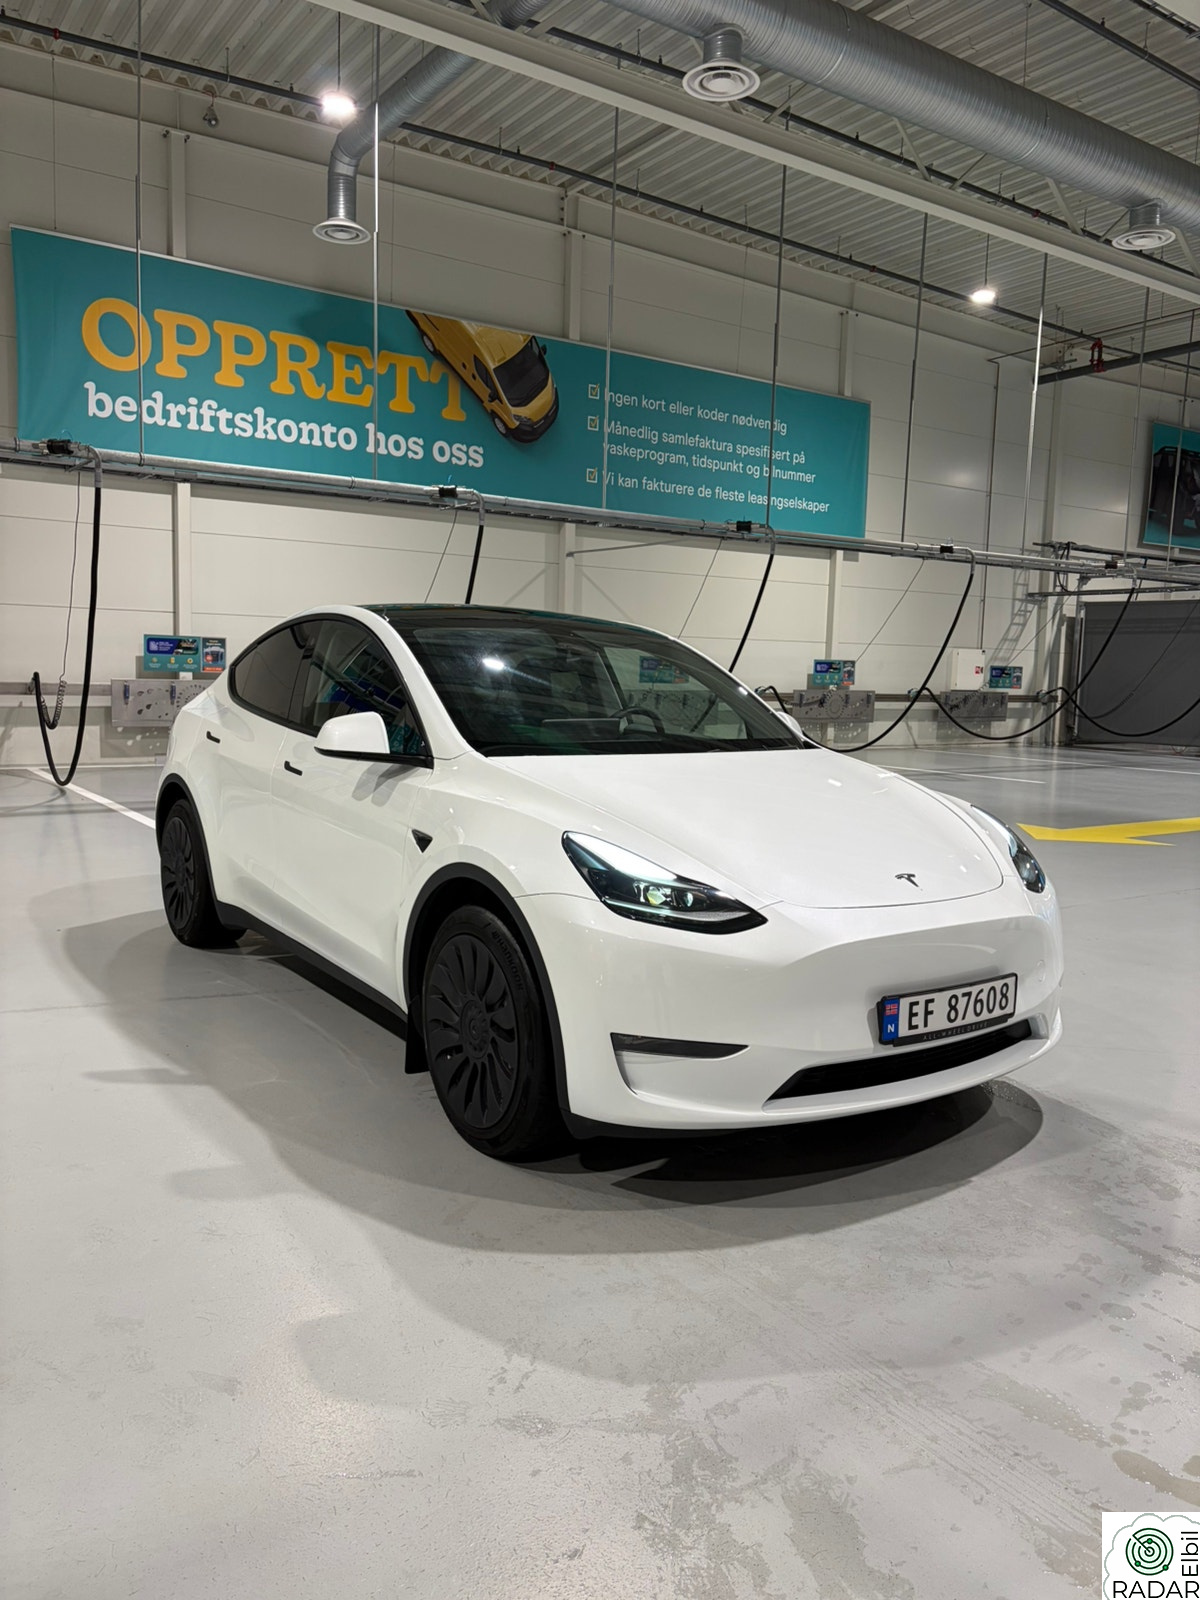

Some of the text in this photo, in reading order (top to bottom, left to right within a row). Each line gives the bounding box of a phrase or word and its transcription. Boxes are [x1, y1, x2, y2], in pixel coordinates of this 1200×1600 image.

[82, 297, 467, 421] OPPRETT
[84, 381, 485, 468] bedriftskonto hos oss
[642, 394, 666, 412] kort
[669, 400, 694, 416] eller
[697, 404, 730, 422] koder
[732, 413, 787, 436] nødvendig
[603, 420, 805, 465] Månedlig samlefaktura spesifisert på
[603, 442, 816, 483] vaskeprogram, tidspunkt og blnummer
[602, 470, 830, 514] Vi kan fakturere de fleste leasngselskaper
[887, 1023, 895, 1033] N
[908, 982, 1009, 1030] EF 87608
